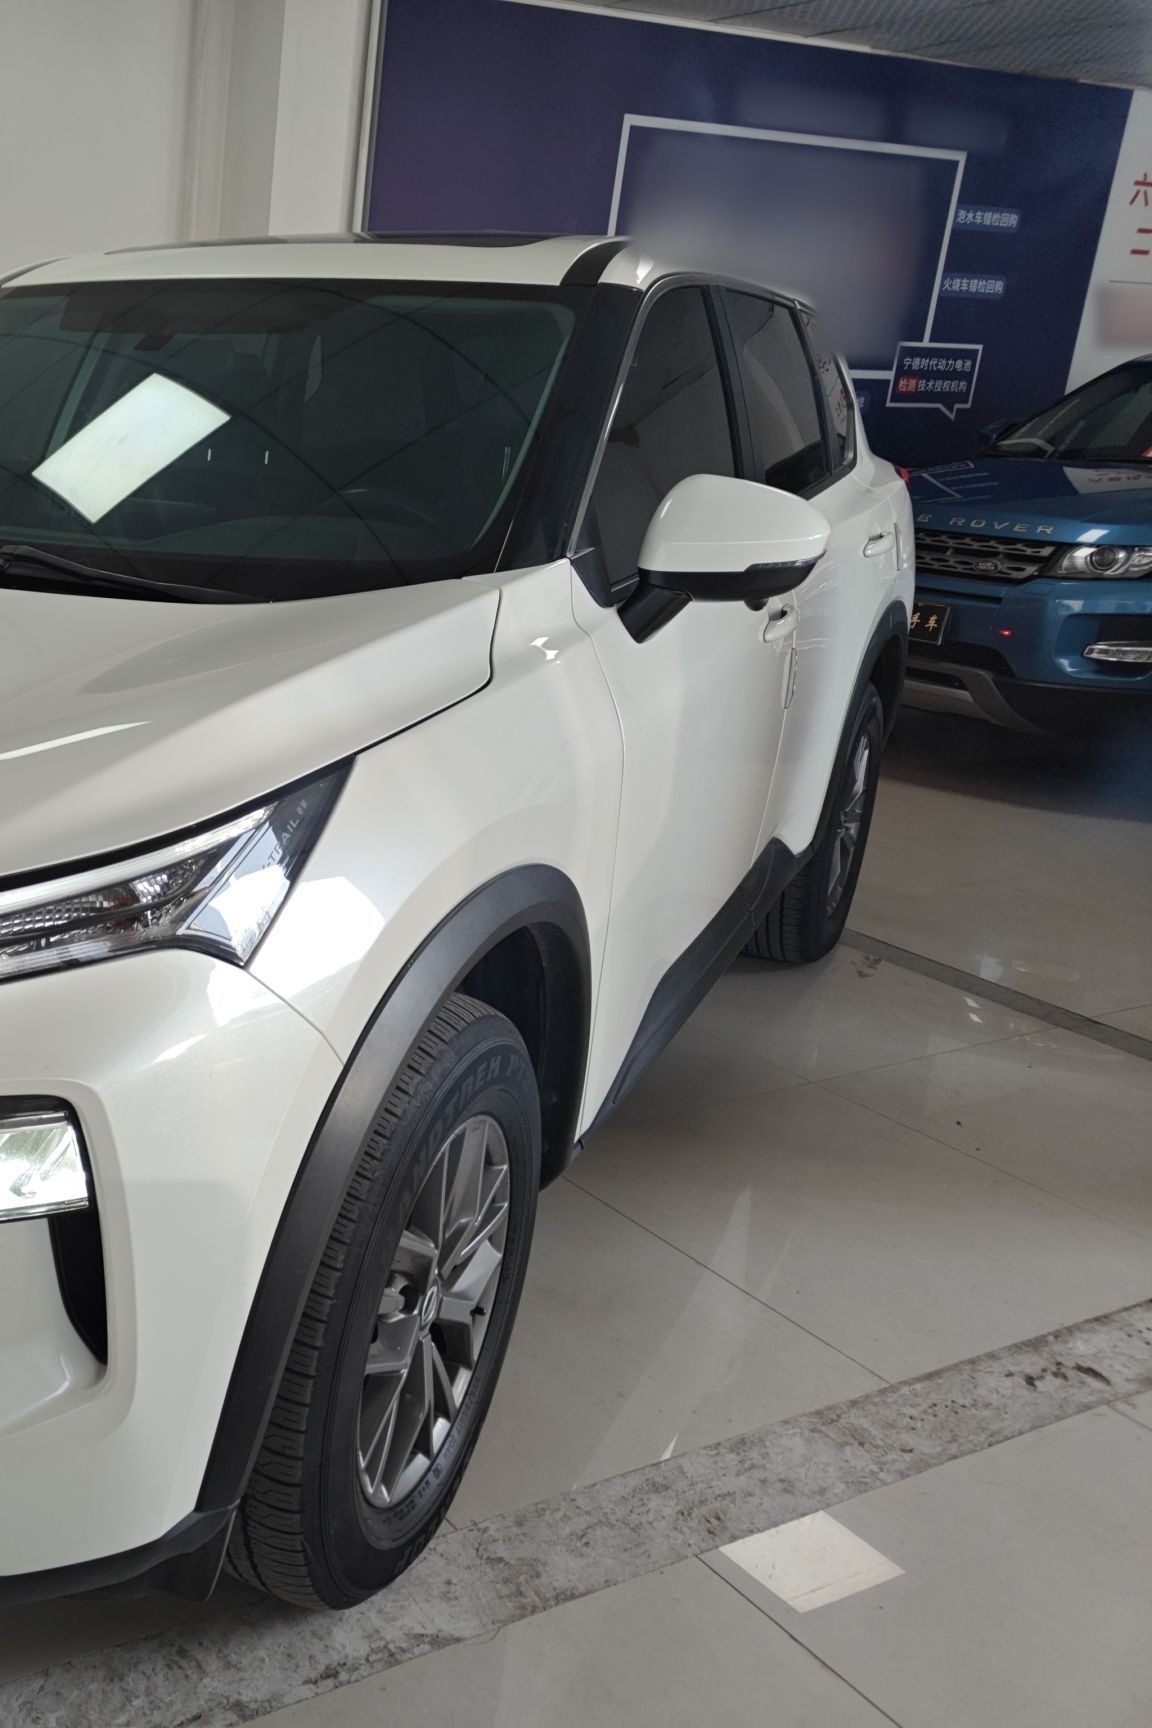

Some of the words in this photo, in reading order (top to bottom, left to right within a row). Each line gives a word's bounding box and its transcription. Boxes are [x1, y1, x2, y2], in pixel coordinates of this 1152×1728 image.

[903, 357, 972, 372] 宁德时代动力电池
[949, 517, 1054, 534] ROVER
